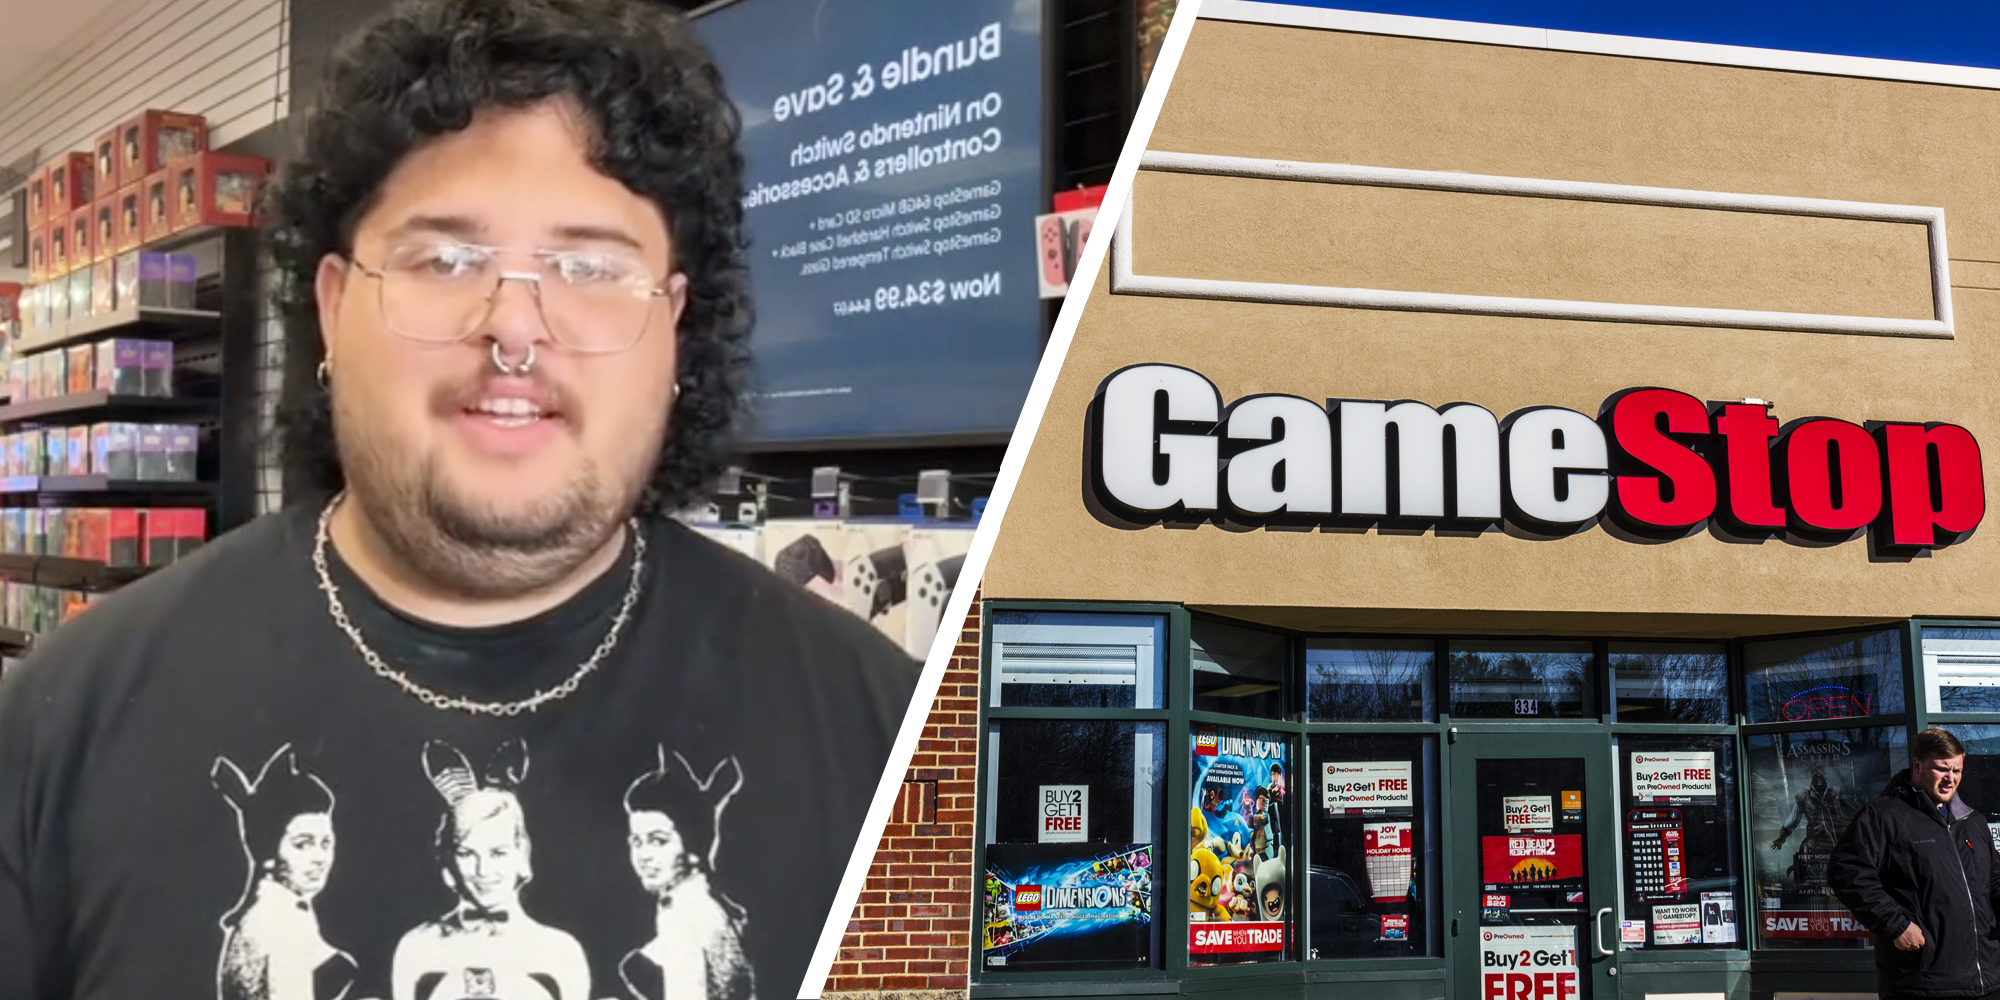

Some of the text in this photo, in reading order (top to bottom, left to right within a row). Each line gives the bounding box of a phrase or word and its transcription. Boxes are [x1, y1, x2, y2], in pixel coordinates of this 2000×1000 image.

[1100, 363, 1986, 547] GameStop
[1516, 700, 1537, 714] 334
[1782, 694, 1870, 721] OPEN
[1198, 727, 1281, 759] LEGO DIMENSIONS
[1801, 754, 1839, 762] CREED
[1814, 760, 1858, 768] COLLECTION
[1206, 775, 1244, 785] AVAILABLE NOW
[1684, 769, 1711, 780] FREE
[1378, 779, 1407, 791] FREE
[1045, 817, 1081, 831] FREE
[1506, 814, 1531, 825] FREE
[1380, 826, 1396, 834] JOY
[1509, 838, 1556, 855] RED DEAD 2
[1509, 848, 1546, 856] REDEMPTION
[1017, 885, 1127, 909] LEGO DIMENSIONS
[1766, 917, 1808, 931] SAVE
[1830, 917, 1869, 931] TRA
[1195, 930, 1232, 945] SAVE
[1233, 937, 1246, 945] YOU
[1247, 929, 1282, 944] TRADE
[1484, 972, 1576, 1000] FREE
